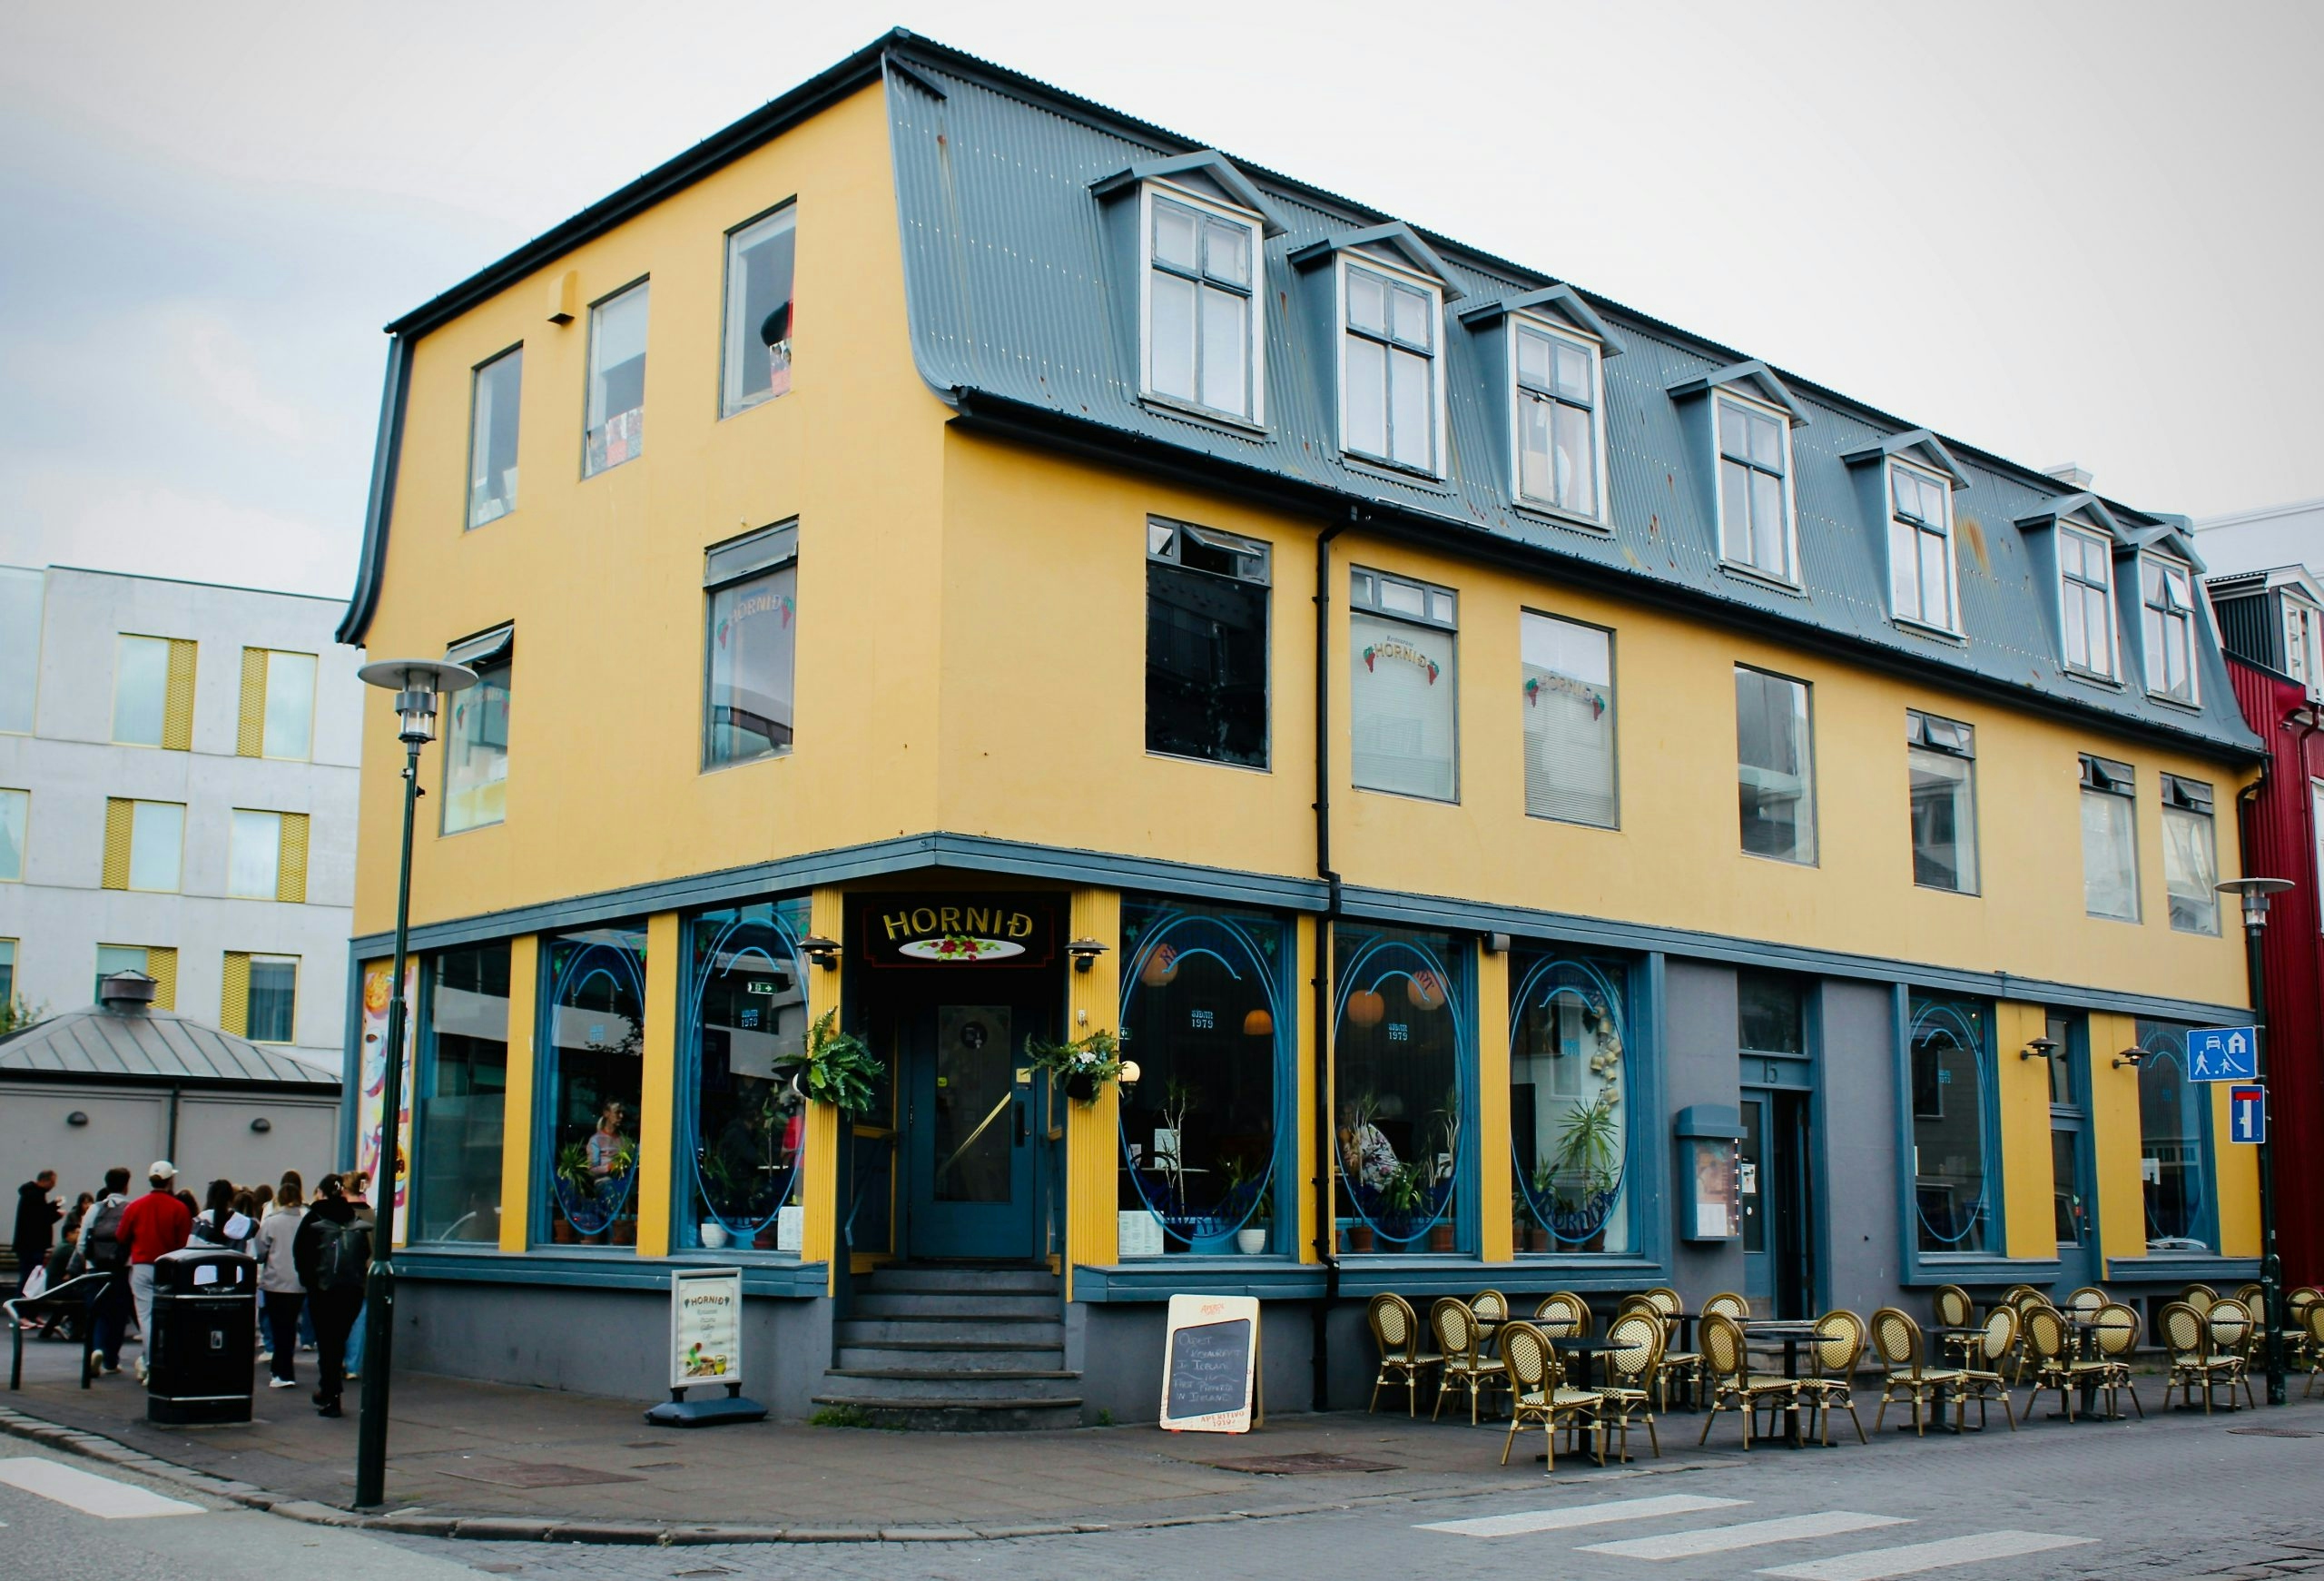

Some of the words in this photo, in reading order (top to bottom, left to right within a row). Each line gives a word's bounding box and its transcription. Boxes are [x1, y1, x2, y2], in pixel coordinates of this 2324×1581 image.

[1374, 643, 1427, 668] HORNIÐ
[883, 907, 1033, 941] HORNIÐ
[741, 1018, 759, 1027] 1979
[1192, 1018, 1214, 1028] 1979
[1389, 1031, 1408, 1041] 1979
[1763, 1060, 1777, 1083] 15
[691, 1295, 724, 1306] HORNIÐ
[1200, 1410, 1245, 1423] APERITIVO
